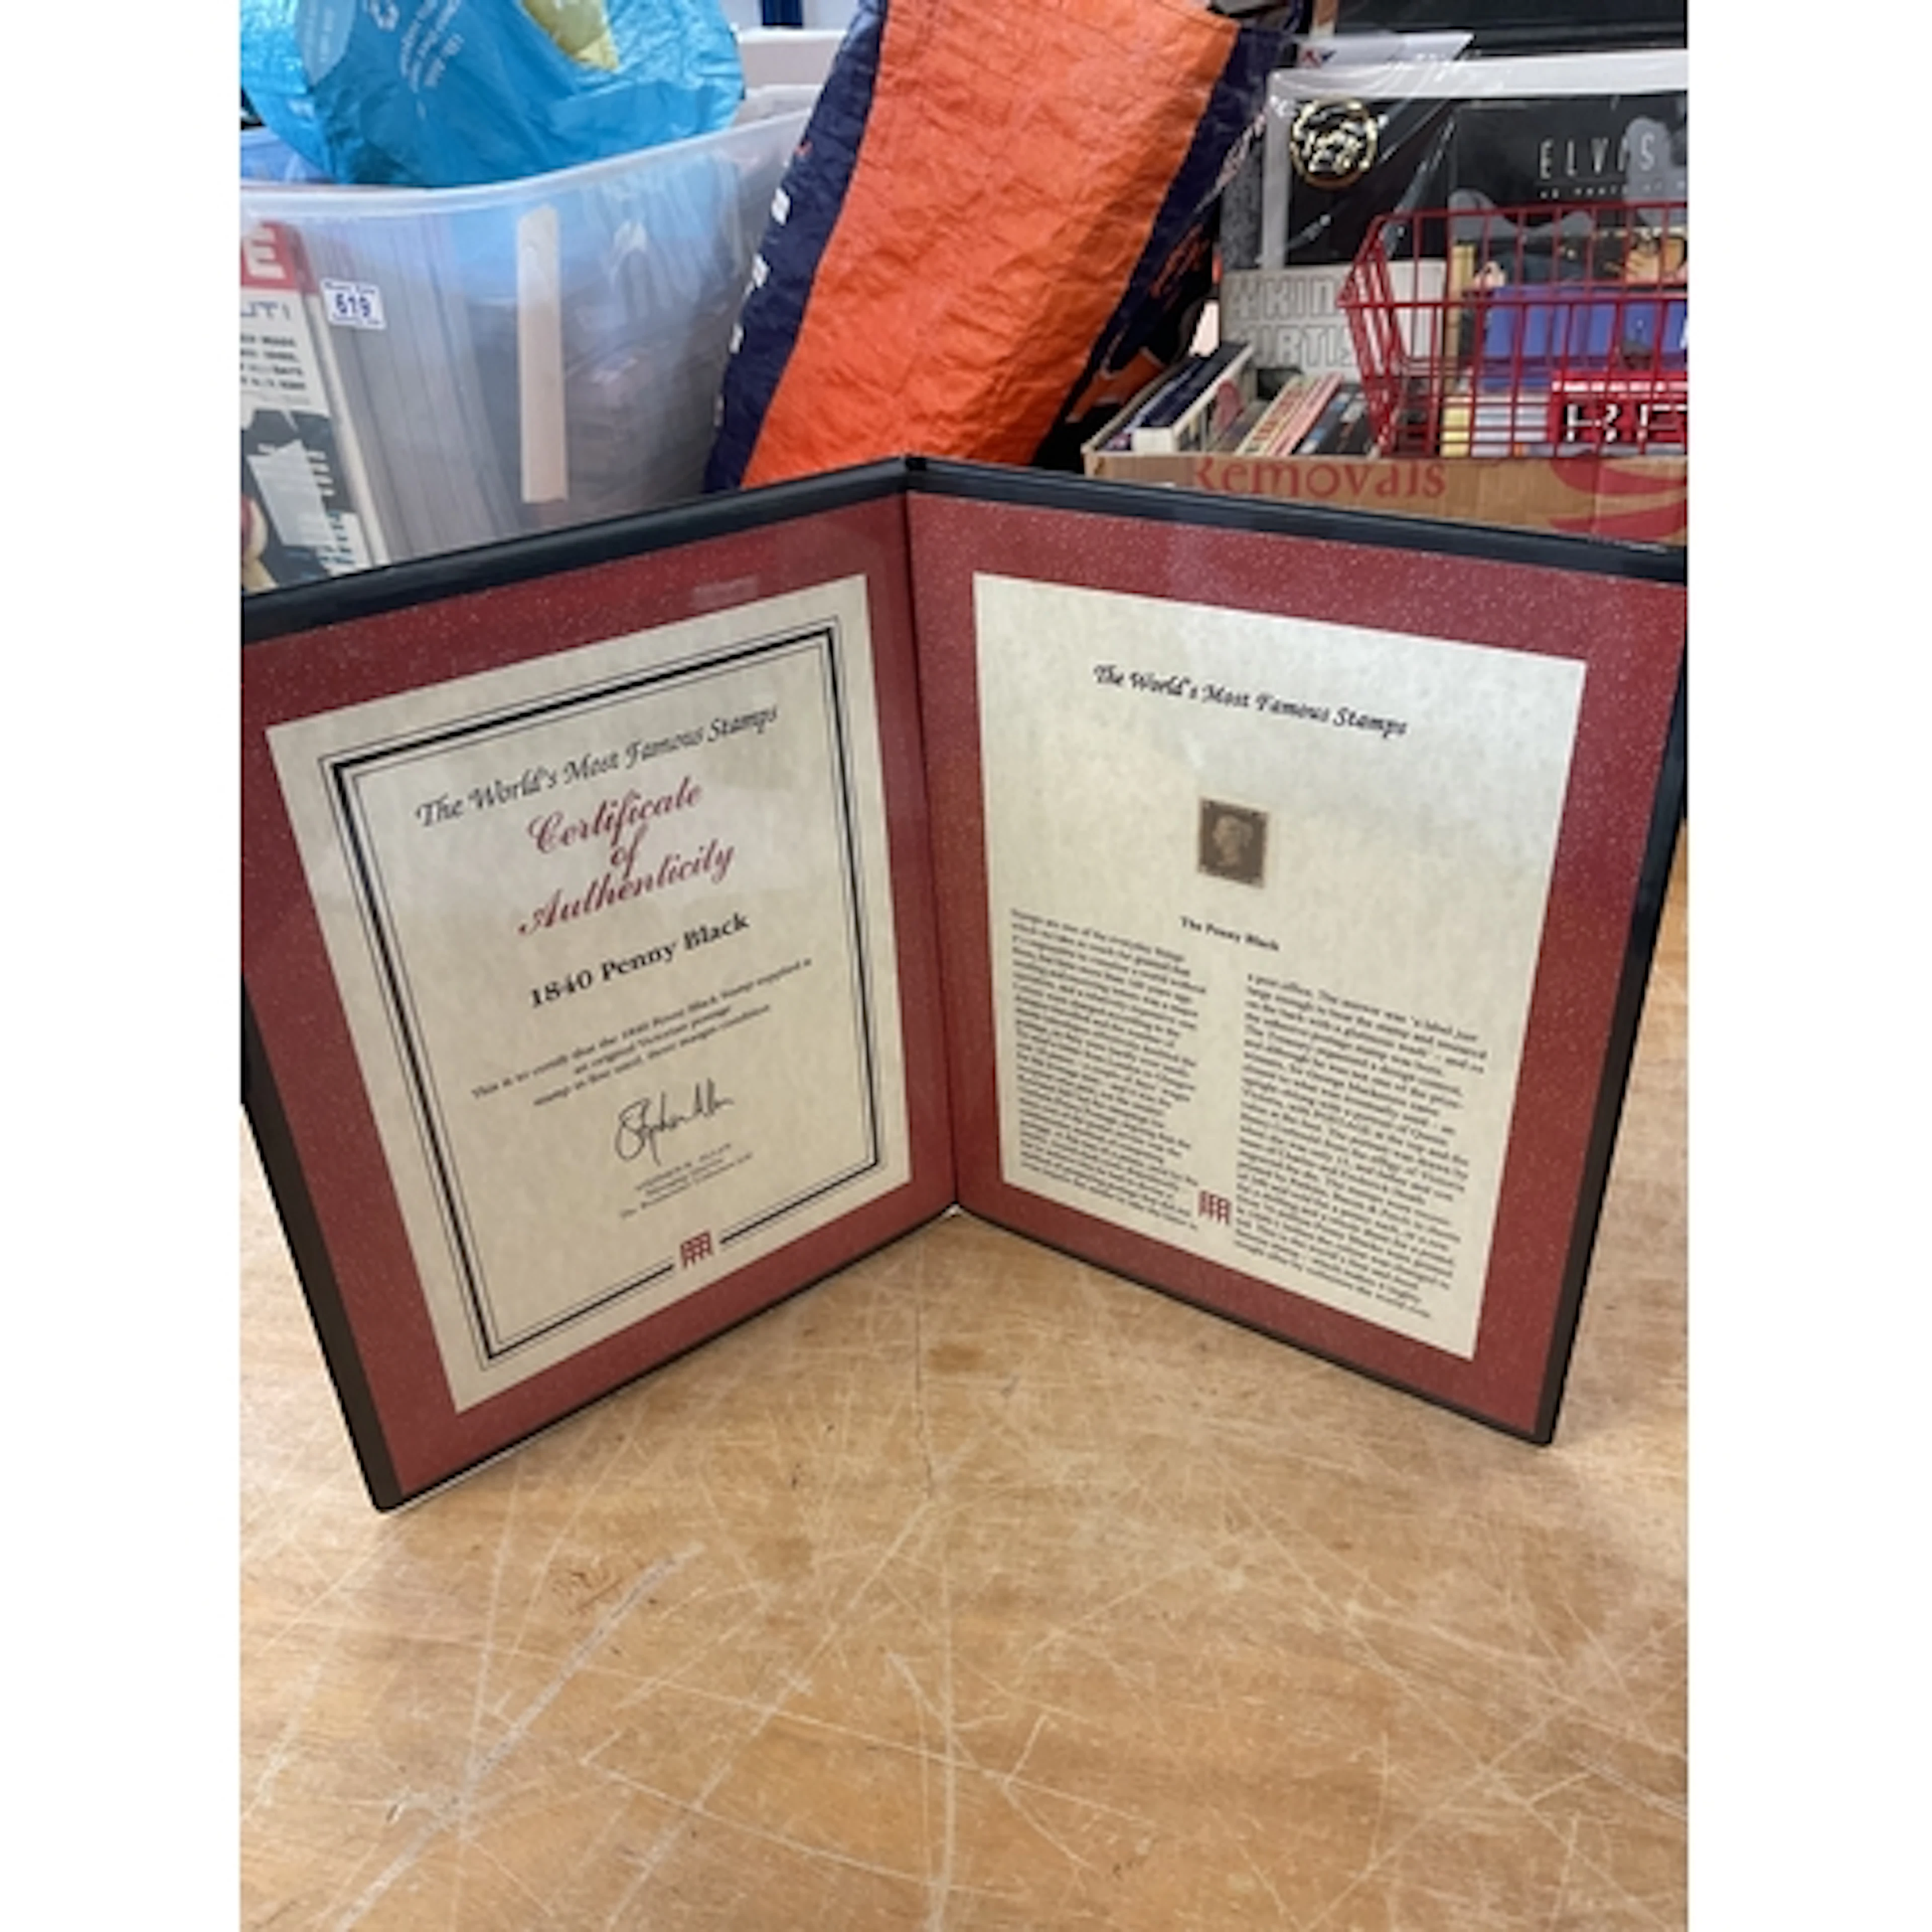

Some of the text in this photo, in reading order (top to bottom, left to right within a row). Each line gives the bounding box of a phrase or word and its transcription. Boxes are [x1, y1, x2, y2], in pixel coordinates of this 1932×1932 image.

[1540, 132, 1657, 179] ELVIS
[1186, 455, 1446, 499] Removals
[1094, 664, 1407, 739] The World's Most Famous Stamps
[416, 703, 777, 827] The World's Most Famous Stamps
[527, 775, 702, 854] Certificate
[517, 837, 736, 937] Authenticity
[610, 826, 648, 880] of
[530, 911, 751, 1009] 1840 Penny Black
[1179, 915, 1279, 951] The Penny Black
